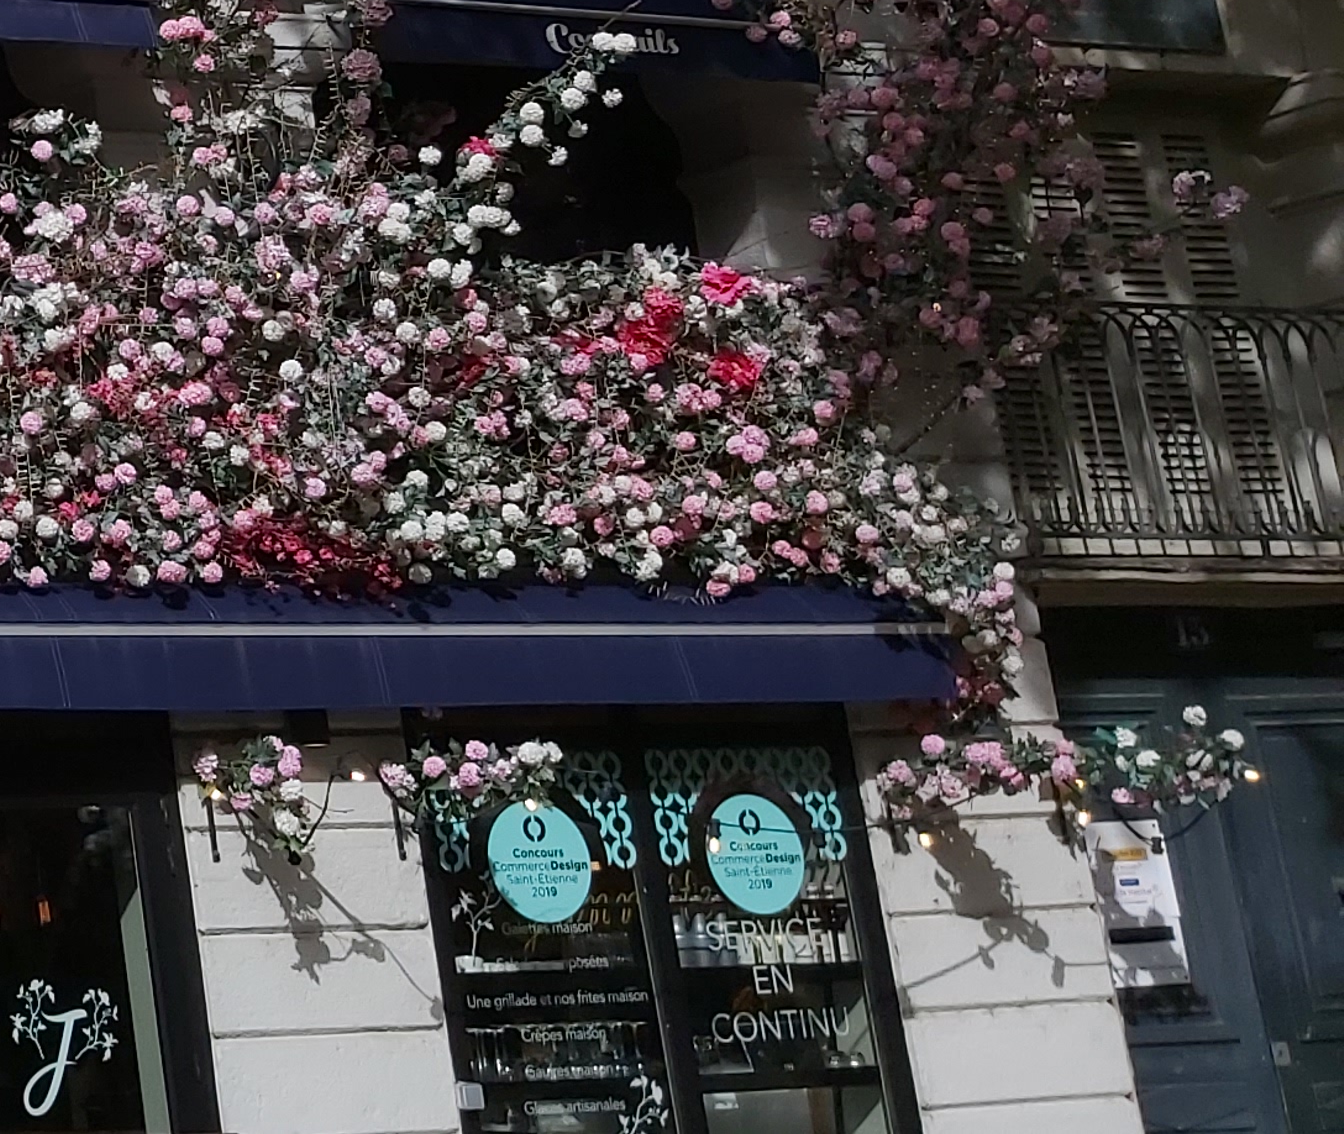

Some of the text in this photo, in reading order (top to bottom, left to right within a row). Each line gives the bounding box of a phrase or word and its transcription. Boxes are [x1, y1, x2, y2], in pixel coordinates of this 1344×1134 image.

[512, 848, 564, 859] Concours
[729, 841, 779, 852] Concours
[493, 859, 588, 872] CommerceDesign
[711, 852, 802, 865] CommerceDesign
[748, 877, 773, 890] 2019
[532, 886, 558, 898] 2019
[552, 921, 593, 934] maison
[705, 918, 822, 953] SERVICE
[752, 964, 794, 995] EN
[466, 989, 649, 1011] Une grillade et nos frites maison
[711, 1006, 850, 1043] CONTINU
[565, 1026, 607, 1042] maison
[23, 1008, 88, 1117] J
[566, 1096, 626, 1113] artisanales
